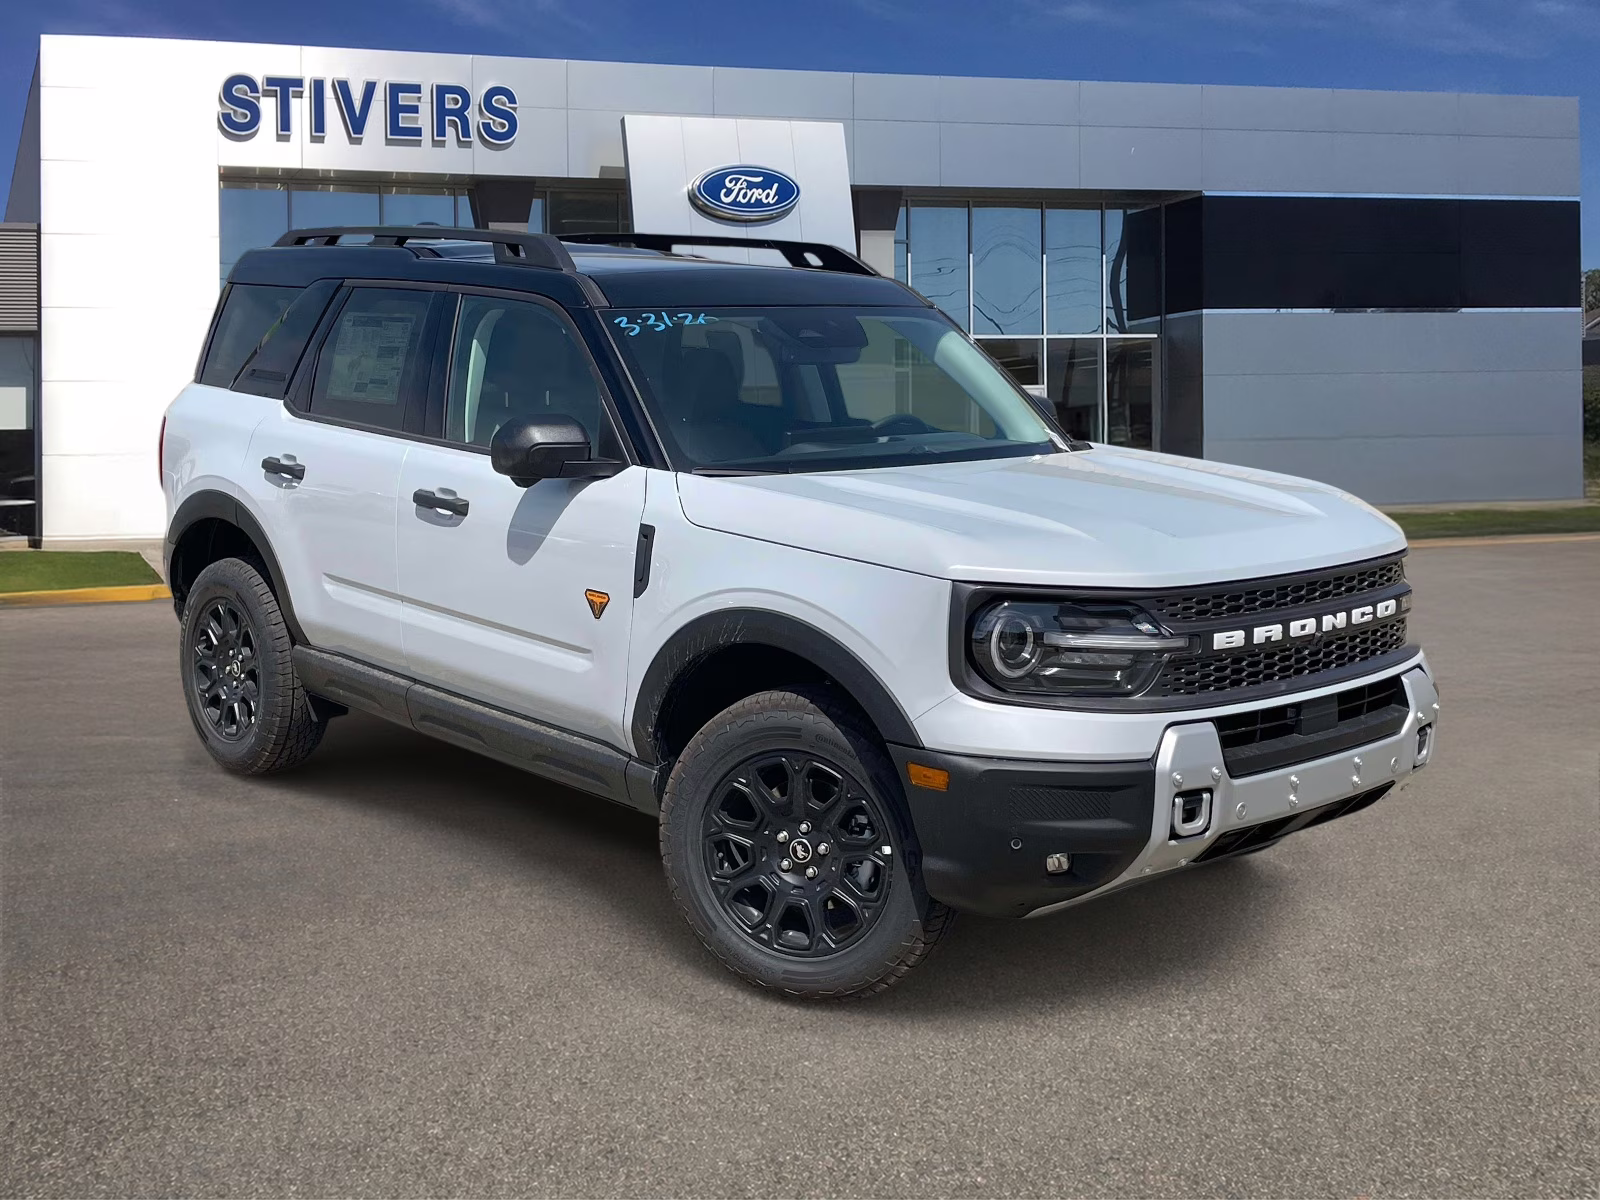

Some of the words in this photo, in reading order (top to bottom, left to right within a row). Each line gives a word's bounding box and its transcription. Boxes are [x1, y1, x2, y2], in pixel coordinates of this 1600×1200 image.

[217, 72, 519, 145] STIVERS
[720, 174, 779, 205] Ford
[1213, 598, 1397, 651] BRONCO
